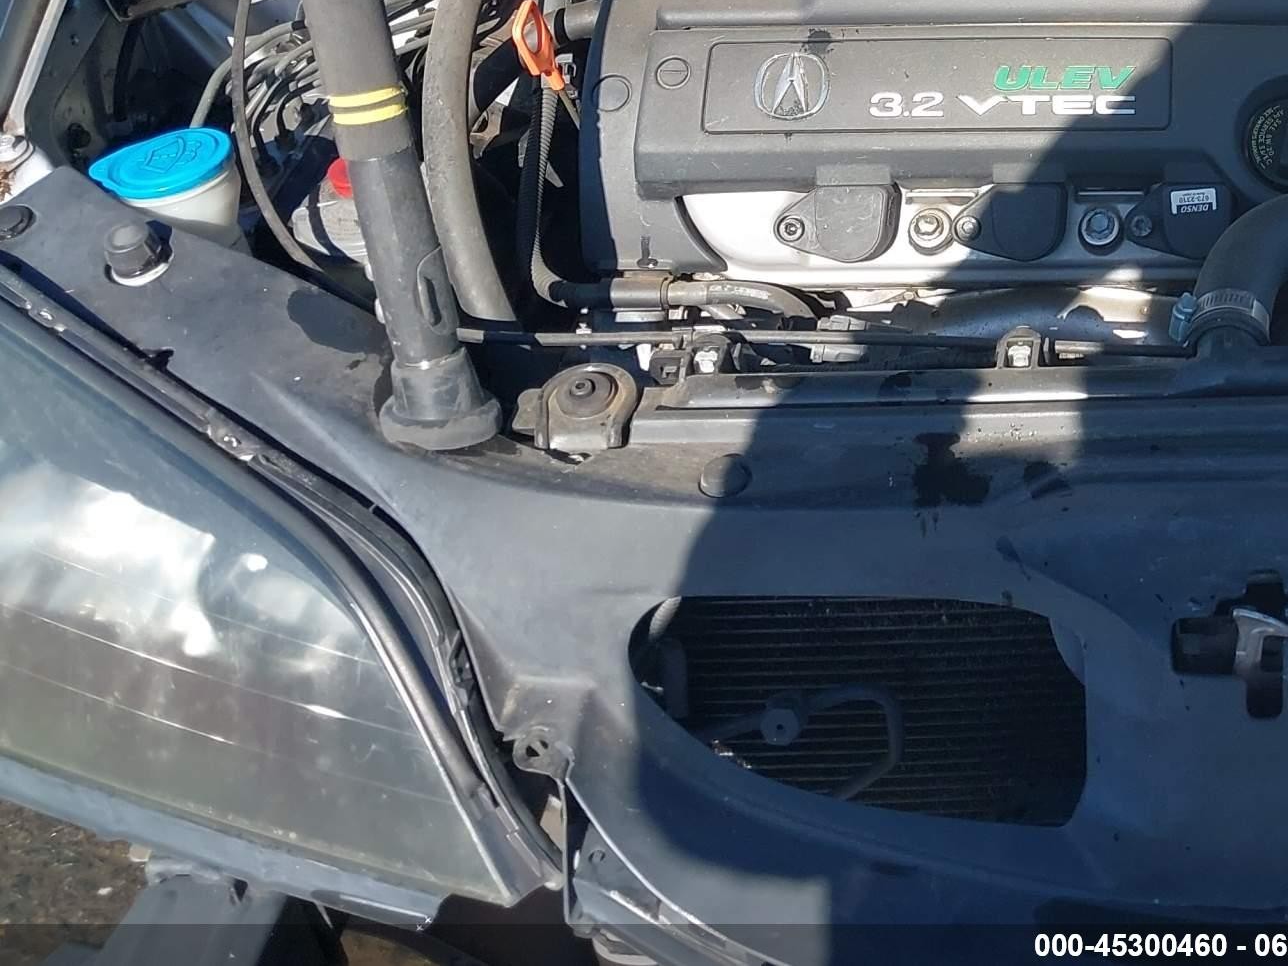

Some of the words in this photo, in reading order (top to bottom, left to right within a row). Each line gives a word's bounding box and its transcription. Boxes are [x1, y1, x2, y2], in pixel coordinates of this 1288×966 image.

[993, 65, 1137, 91] ULEV
[869, 91, 944, 118] 3.2
[956, 94, 1136, 116] VTEC
[1180, 203, 1210, 213] DENSO
